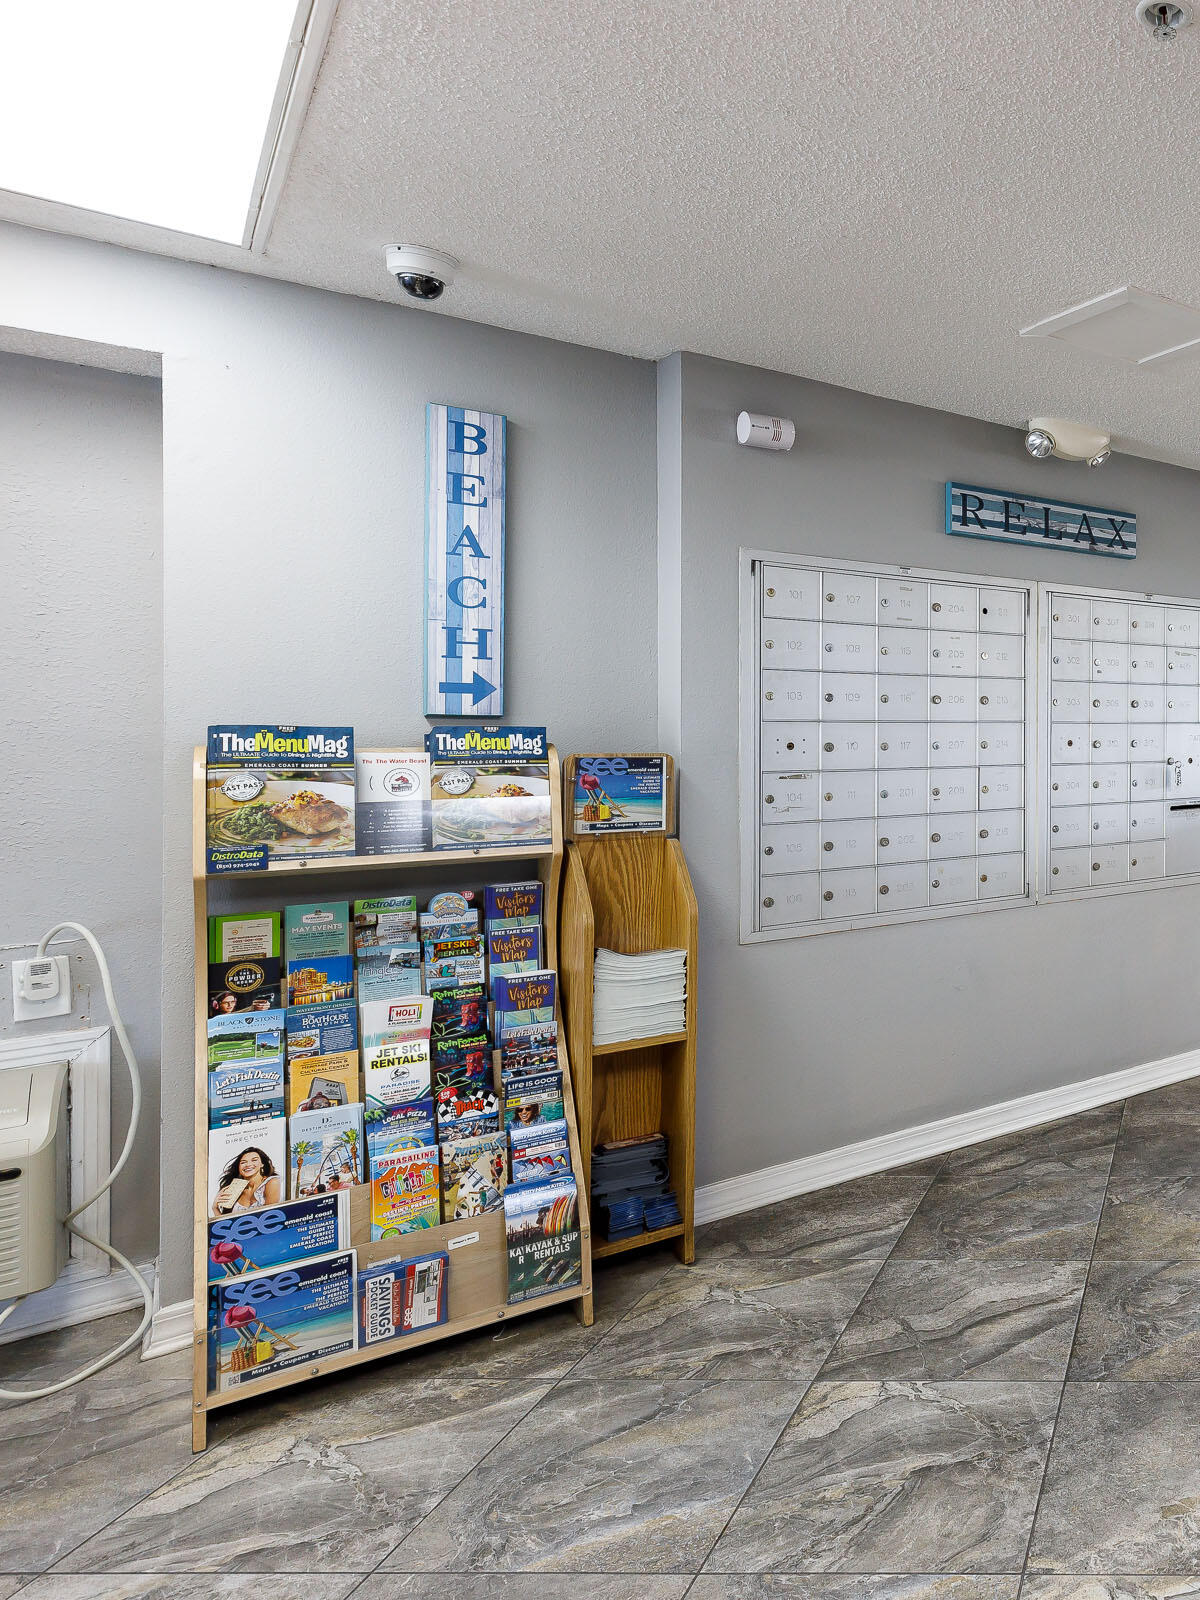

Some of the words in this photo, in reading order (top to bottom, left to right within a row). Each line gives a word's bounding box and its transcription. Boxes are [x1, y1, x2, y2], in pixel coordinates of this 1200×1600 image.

[960, 492, 1129, 550] RELAX
[441, 419, 494, 661] BEACH
[786, 641, 802, 650] 102
[580, 757, 628, 776] see
[211, 850, 264, 861] DistroData
[362, 899, 412, 909] DistroData
[291, 926, 311, 934] MAY
[312, 923, 343, 931] EVENTS
[229, 974, 261, 982] POWDER
[396, 1008, 416, 1017] HOLI
[376, 1047, 398, 1059] JET
[371, 1053, 428, 1070] RENTALS!
[453, 1098, 485, 1116] TRACK
[324, 1120, 352, 1128] COMMONS
[382, 1113, 405, 1125] LOCAL
[225, 1132, 269, 1144] DIRECTORY
[378, 1150, 436, 1169] PARASAILING
[284, 1213, 314, 1226] emerald
[315, 1210, 333, 1218] coast
[211, 1209, 287, 1246] see
[308, 1220, 335, 1229] ULTIMATE
[308, 1226, 326, 1234] GUIDE
[312, 1229, 335, 1238] PERFECT
[289, 1239, 315, 1249] EMERALD
[316, 1234, 335, 1242] COAST
[304, 1239, 335, 1250] VACATION!
[525, 1238, 553, 1254] KAYAK
[554, 1236, 561, 1245] &
[562, 1232, 578, 1243] SUP
[534, 1242, 571, 1260] RENTALS
[298, 1274, 328, 1287] emerald
[329, 1269, 347, 1279] coast
[224, 1270, 300, 1309] see
[322, 1287, 340, 1295] GUIDE
[323, 1280, 349, 1290] ULTIMATE
[327, 1289, 349, 1299] PERFECT
[370, 1280, 379, 1311] POCKET
[318, 1299, 349, 1311] VACATION!
[378, 1276, 391, 1336] SAVINGS
[370, 1312, 379, 1339] GUIDE
[318, 1342, 350, 1355] Discounts
[279, 1354, 310, 1367] Coupons
[251, 1365, 271, 1376] Maps
